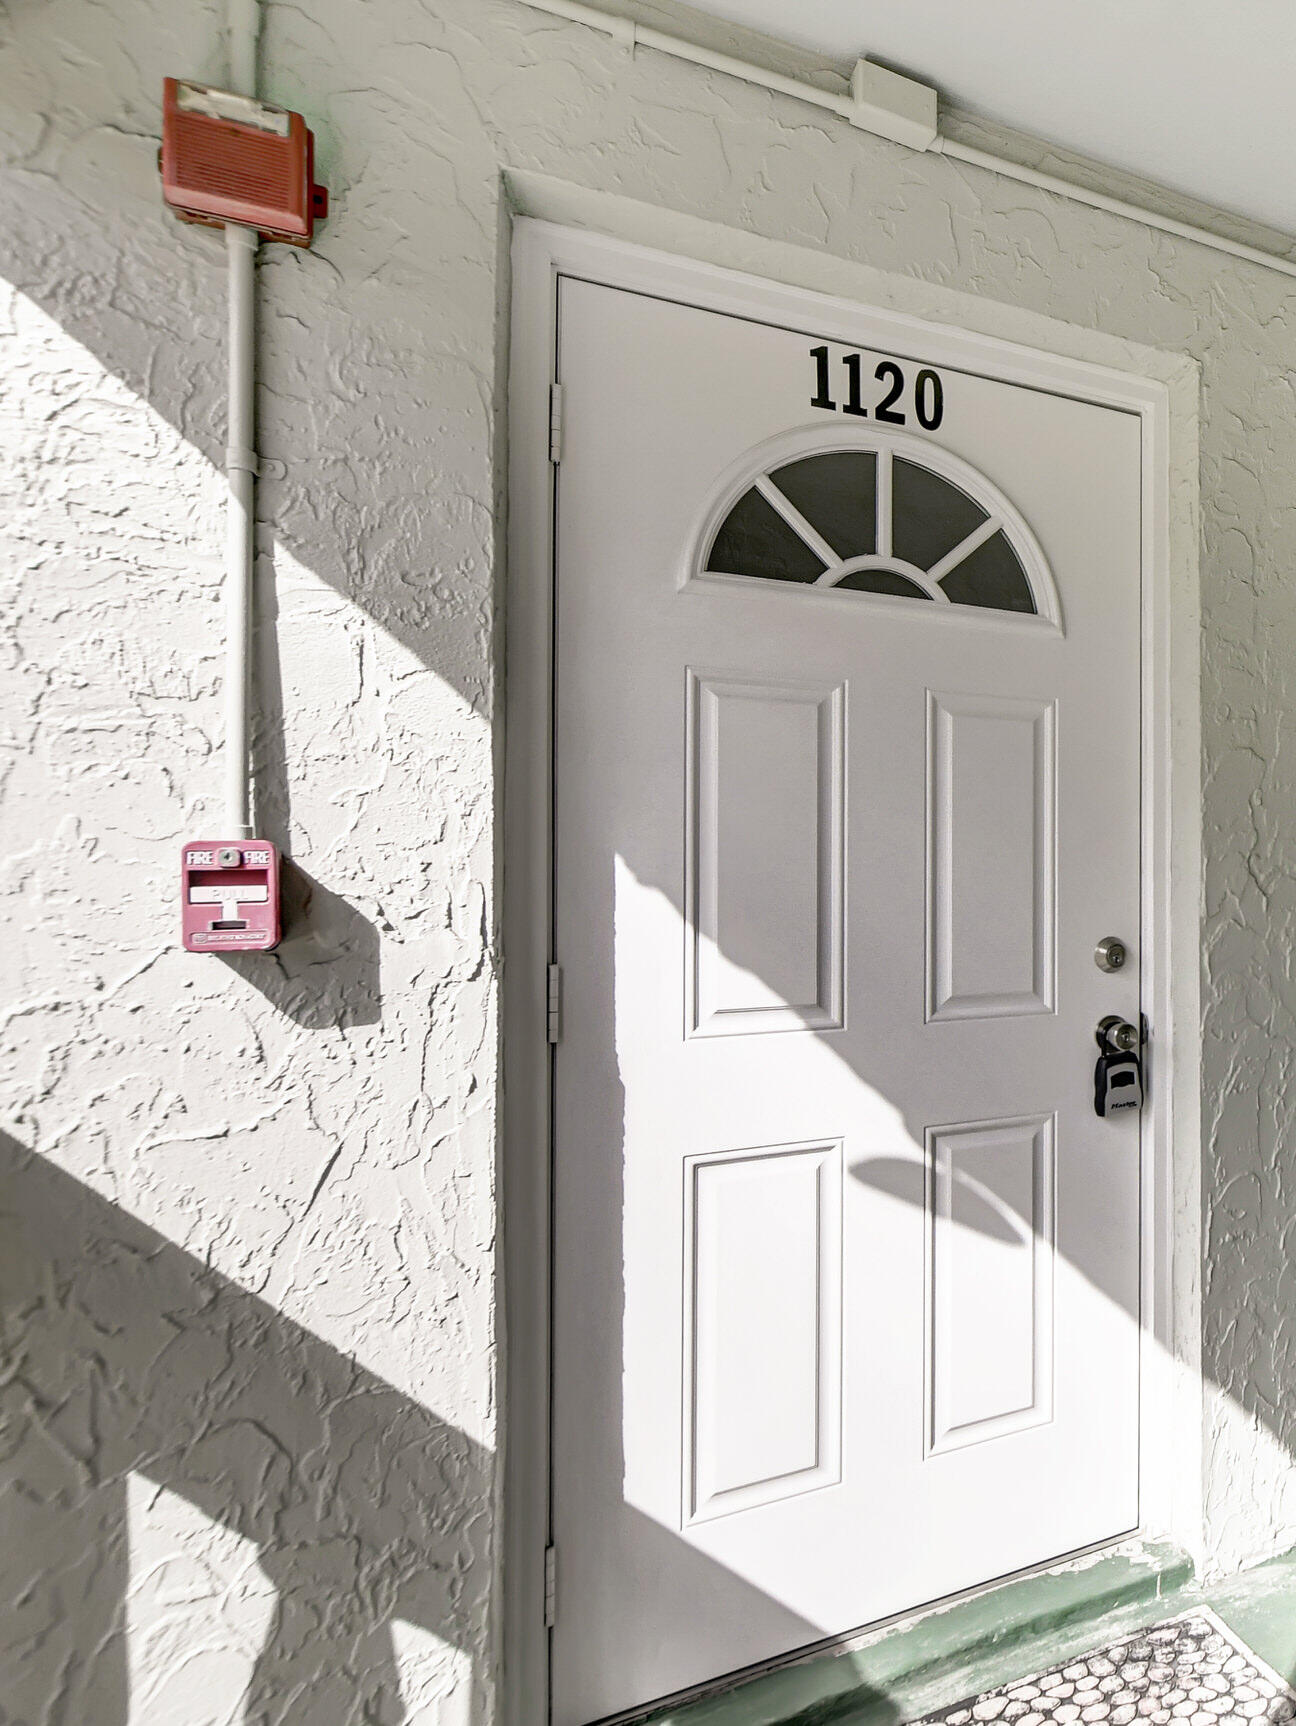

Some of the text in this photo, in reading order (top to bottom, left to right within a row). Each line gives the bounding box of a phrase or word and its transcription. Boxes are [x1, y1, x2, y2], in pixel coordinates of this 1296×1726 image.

[810, 346, 943, 431] 1120
[186, 850, 270, 865] FIRE FIRE
